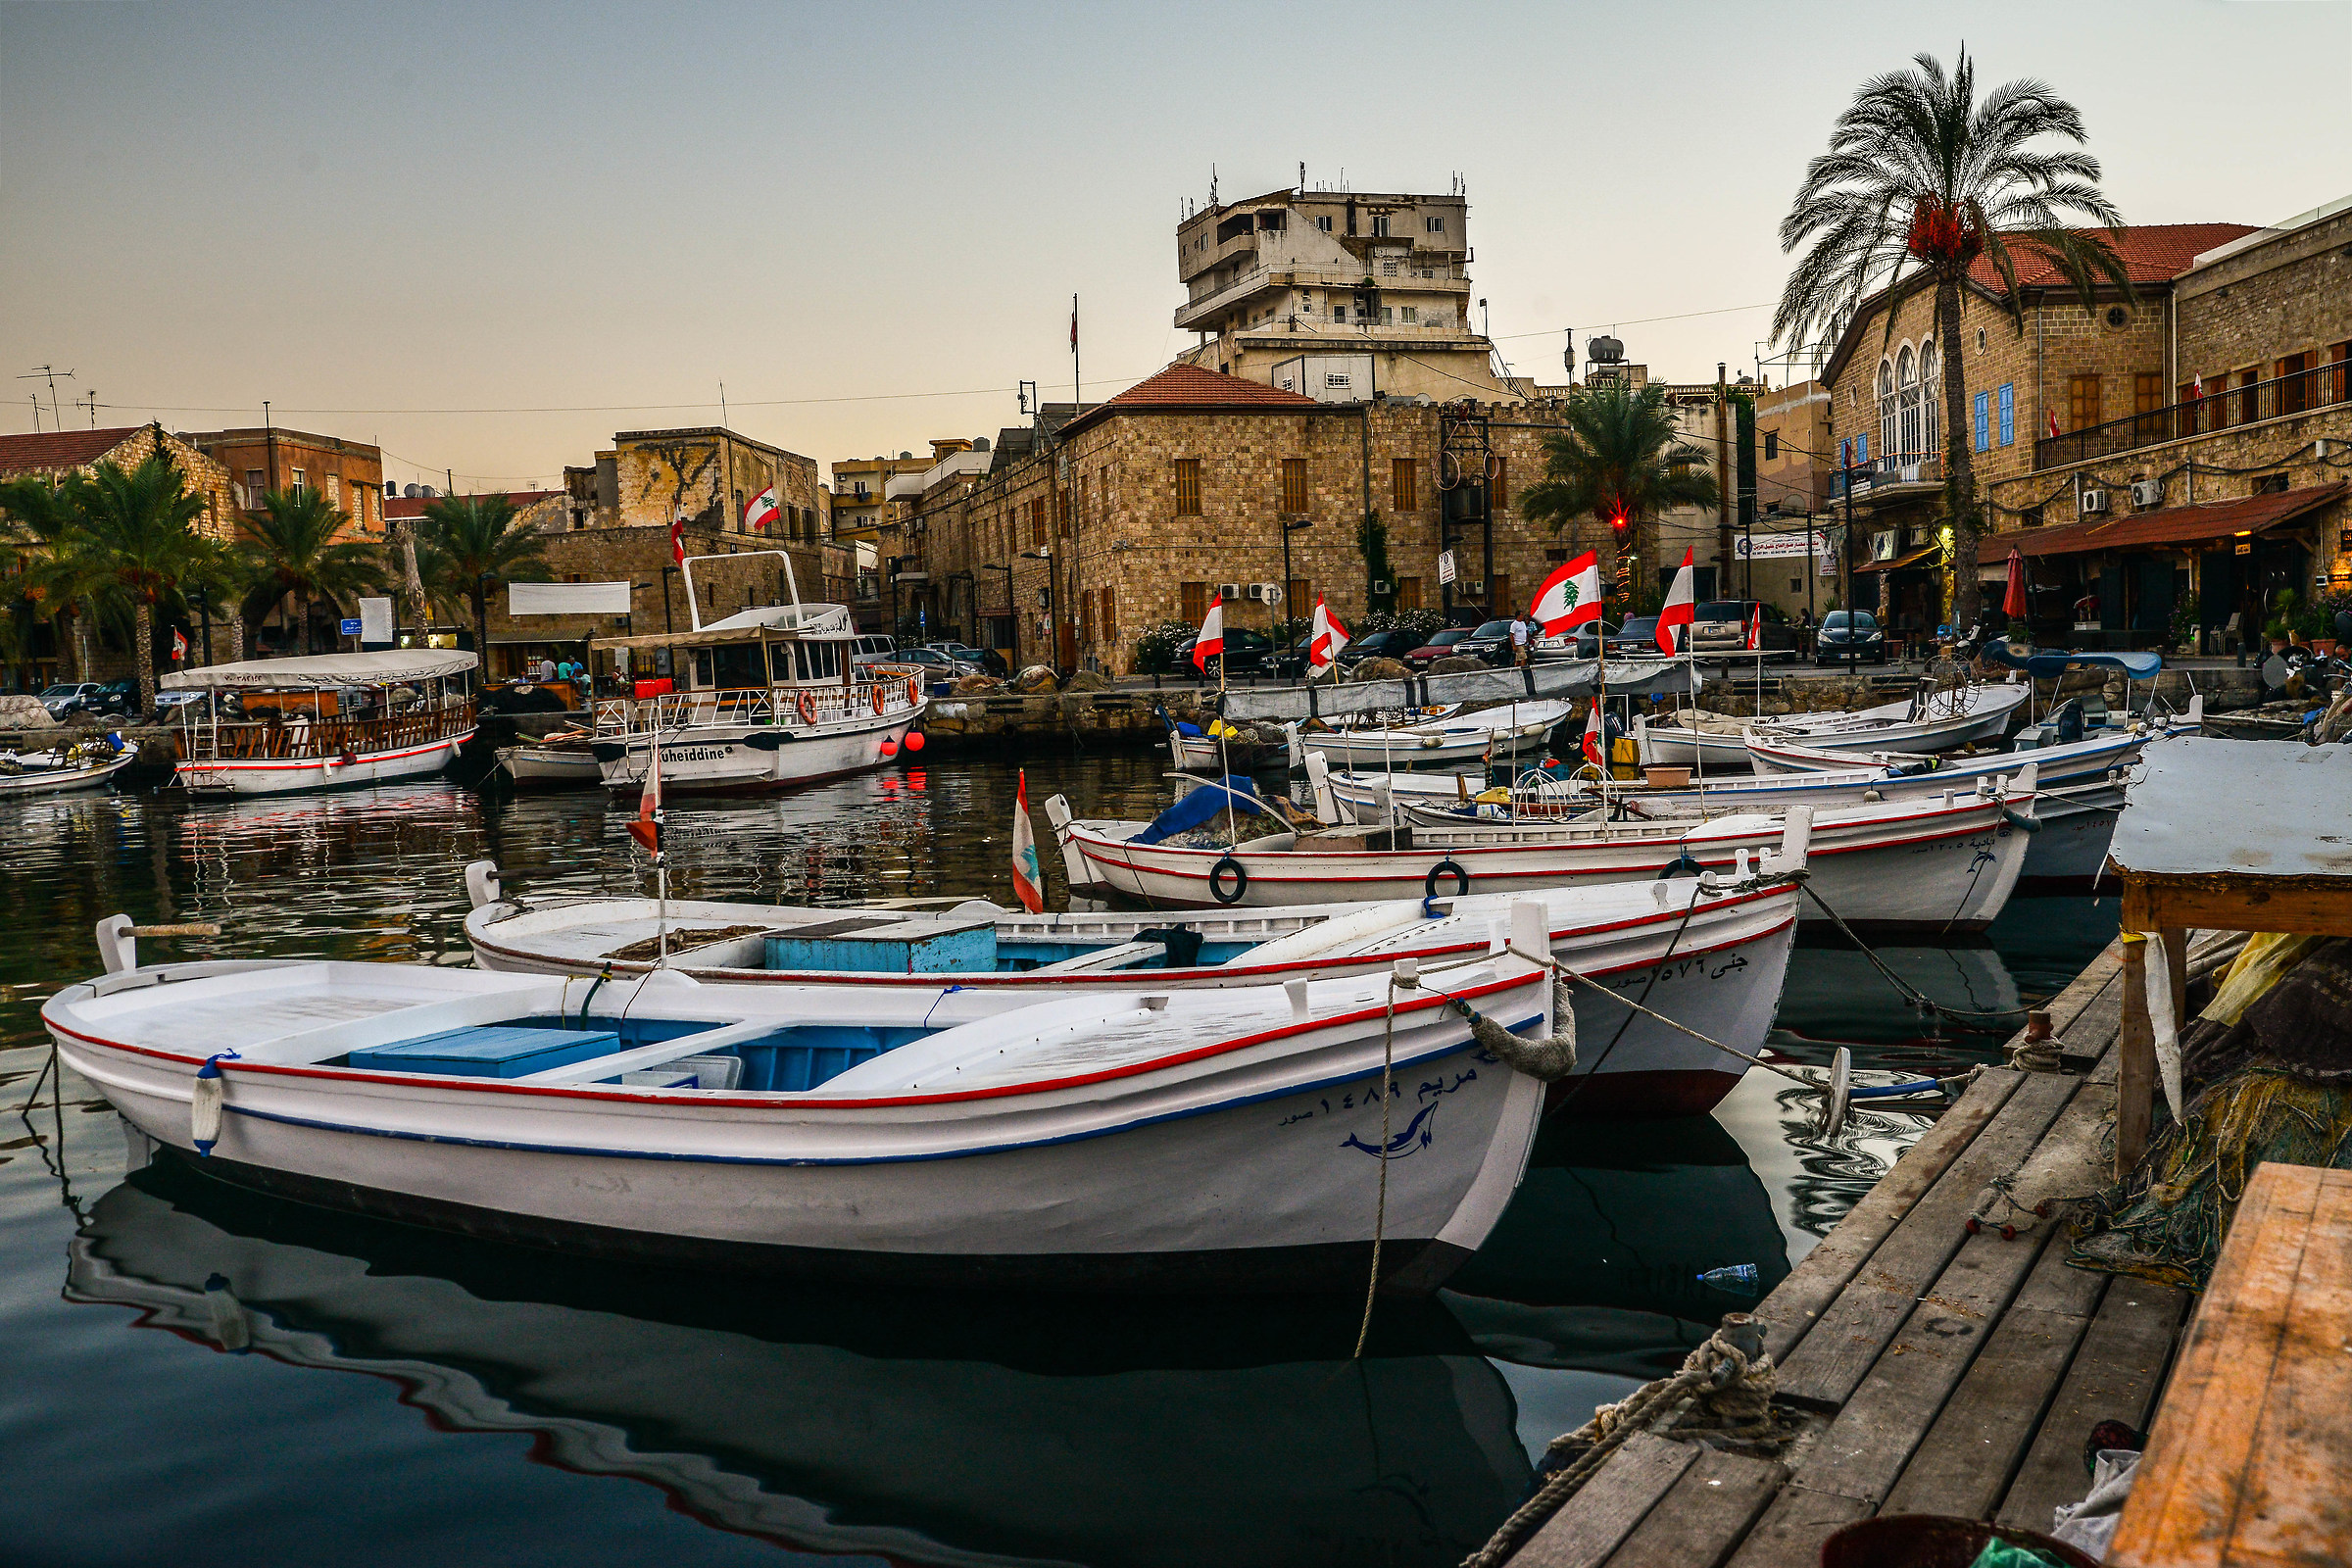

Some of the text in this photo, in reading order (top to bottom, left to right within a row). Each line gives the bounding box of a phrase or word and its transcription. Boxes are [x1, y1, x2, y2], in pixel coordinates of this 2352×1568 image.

[1278, 1067, 1478, 1127] مريم ١٤٨٩ صور
